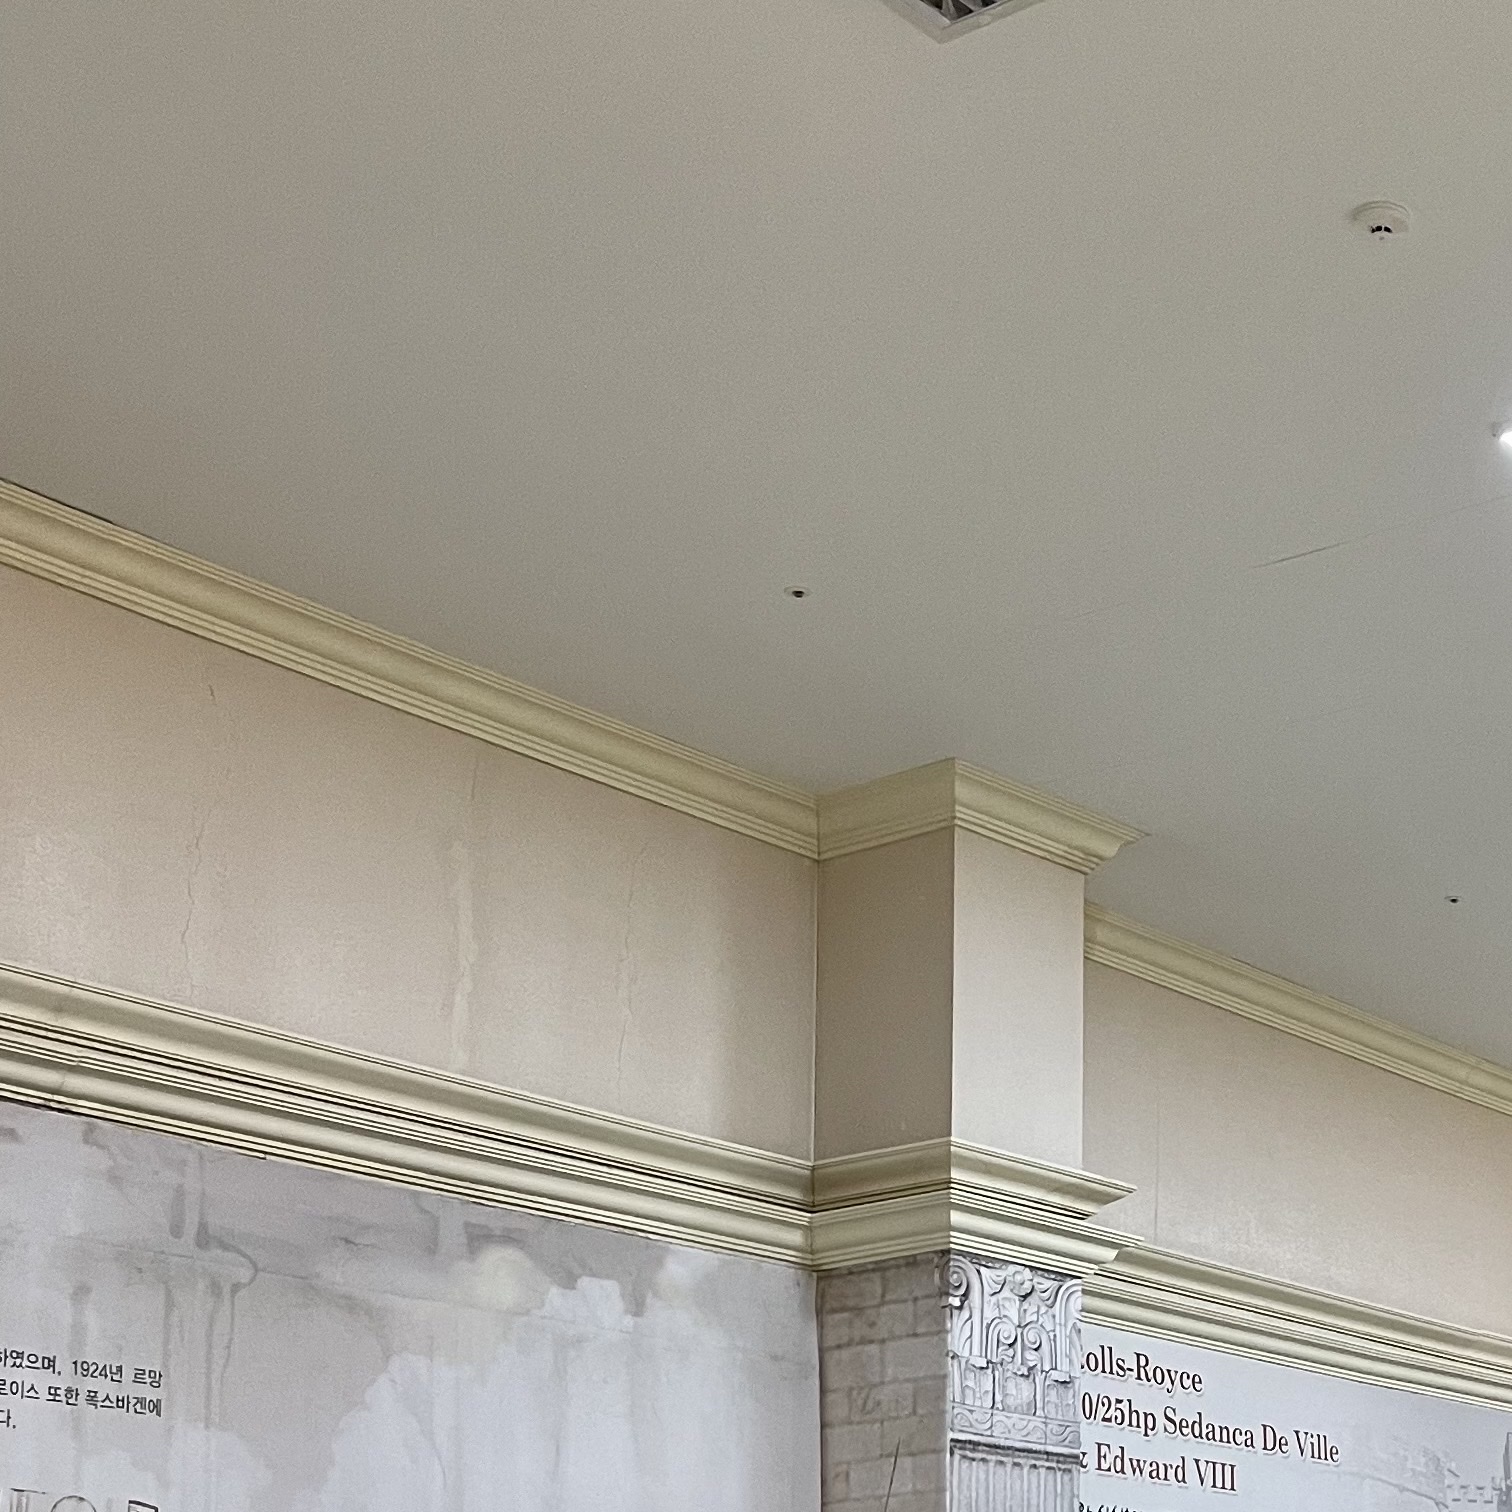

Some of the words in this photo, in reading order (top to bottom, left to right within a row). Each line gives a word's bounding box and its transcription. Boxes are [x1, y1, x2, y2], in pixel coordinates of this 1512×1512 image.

[72, 1359, 123, 1383] 1924년
[132, 1367, 163, 1389] 르망
[1081, 1345, 1203, 1394] olls-Royce
[46, 1385, 80, 1406] 또한
[85, 1389, 163, 1418] 폭스바겐에
[1163, 1405, 1256, 1450] Sedanca
[1261, 1423, 1290, 1454] De
[1292, 1429, 1340, 1463] Ville
[1095, 1441, 1188, 1485] Edward
[1193, 1457, 1238, 1492] VIII
